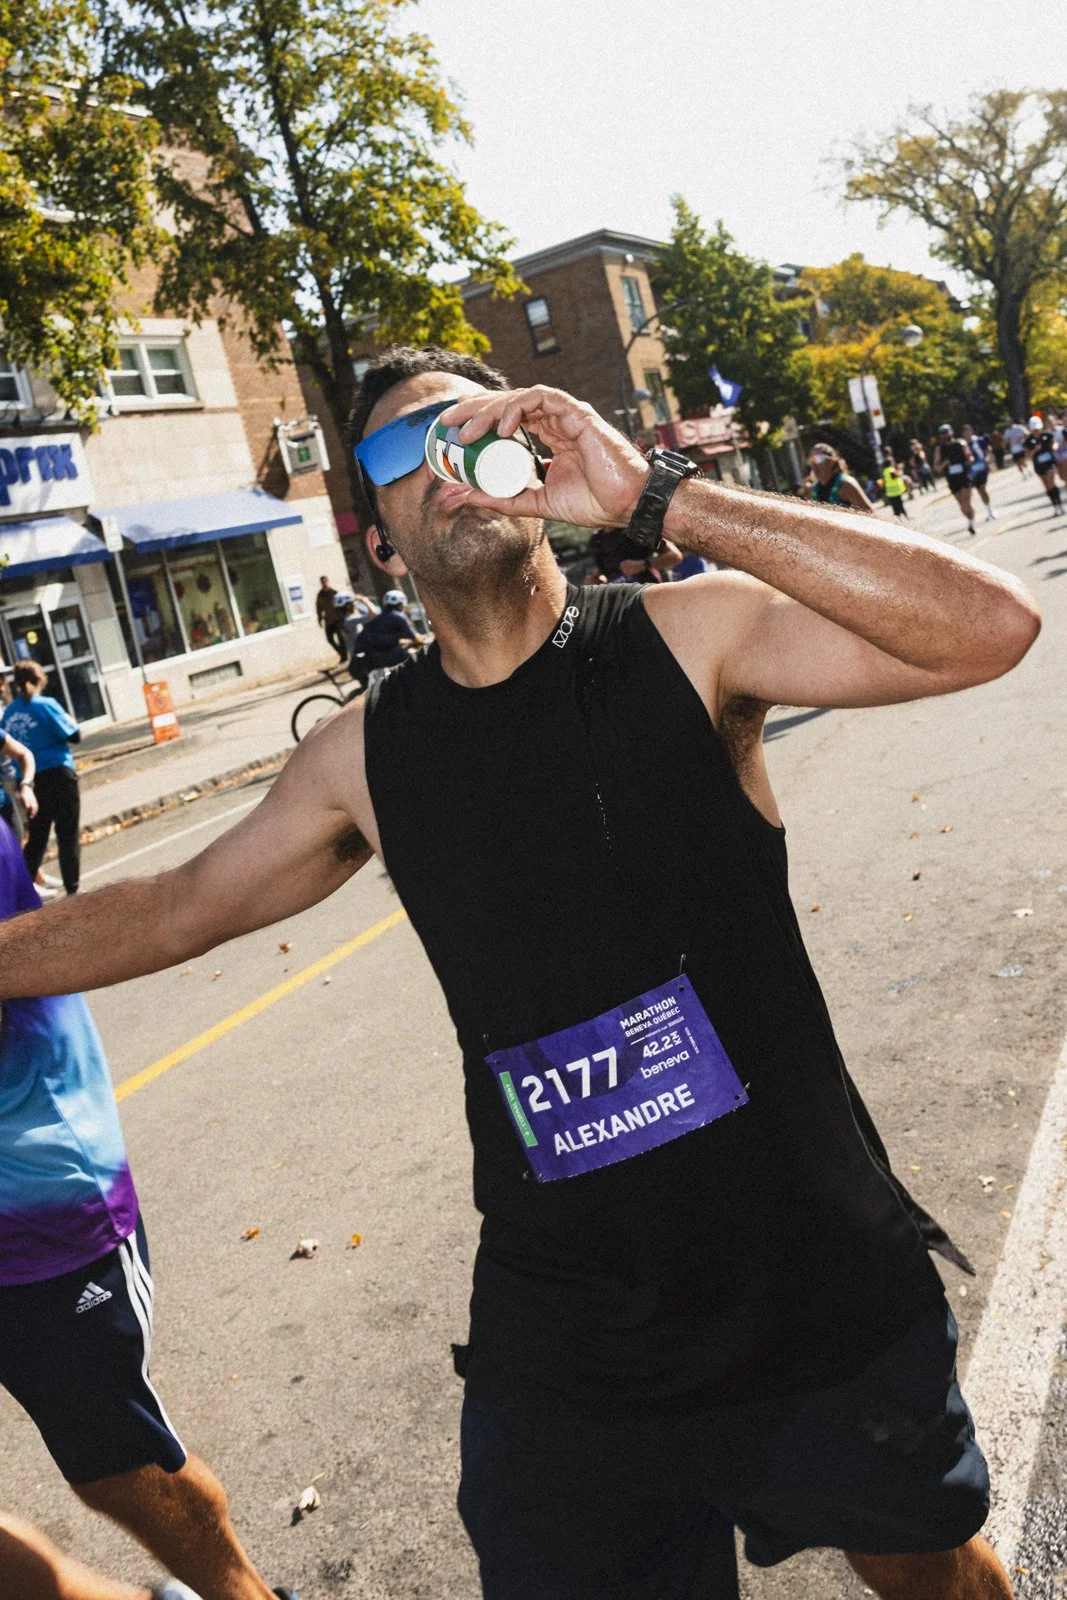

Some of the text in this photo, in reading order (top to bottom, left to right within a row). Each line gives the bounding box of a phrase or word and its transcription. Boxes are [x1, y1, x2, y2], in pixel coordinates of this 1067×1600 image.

[620, 996, 677, 1029] MARATHON
[625, 1020, 653, 1037] BENEVA
[653, 1006, 681, 1024] QUÉBEC
[642, 1035, 674, 1058] 42.2
[670, 1031, 682, 1046] KM
[521, 1047, 618, 1113] 2177
[640, 1050, 690, 1079] beneva
[554, 1083, 696, 1156] ALEXANDRE
[75, 1290, 113, 1313] adidas
